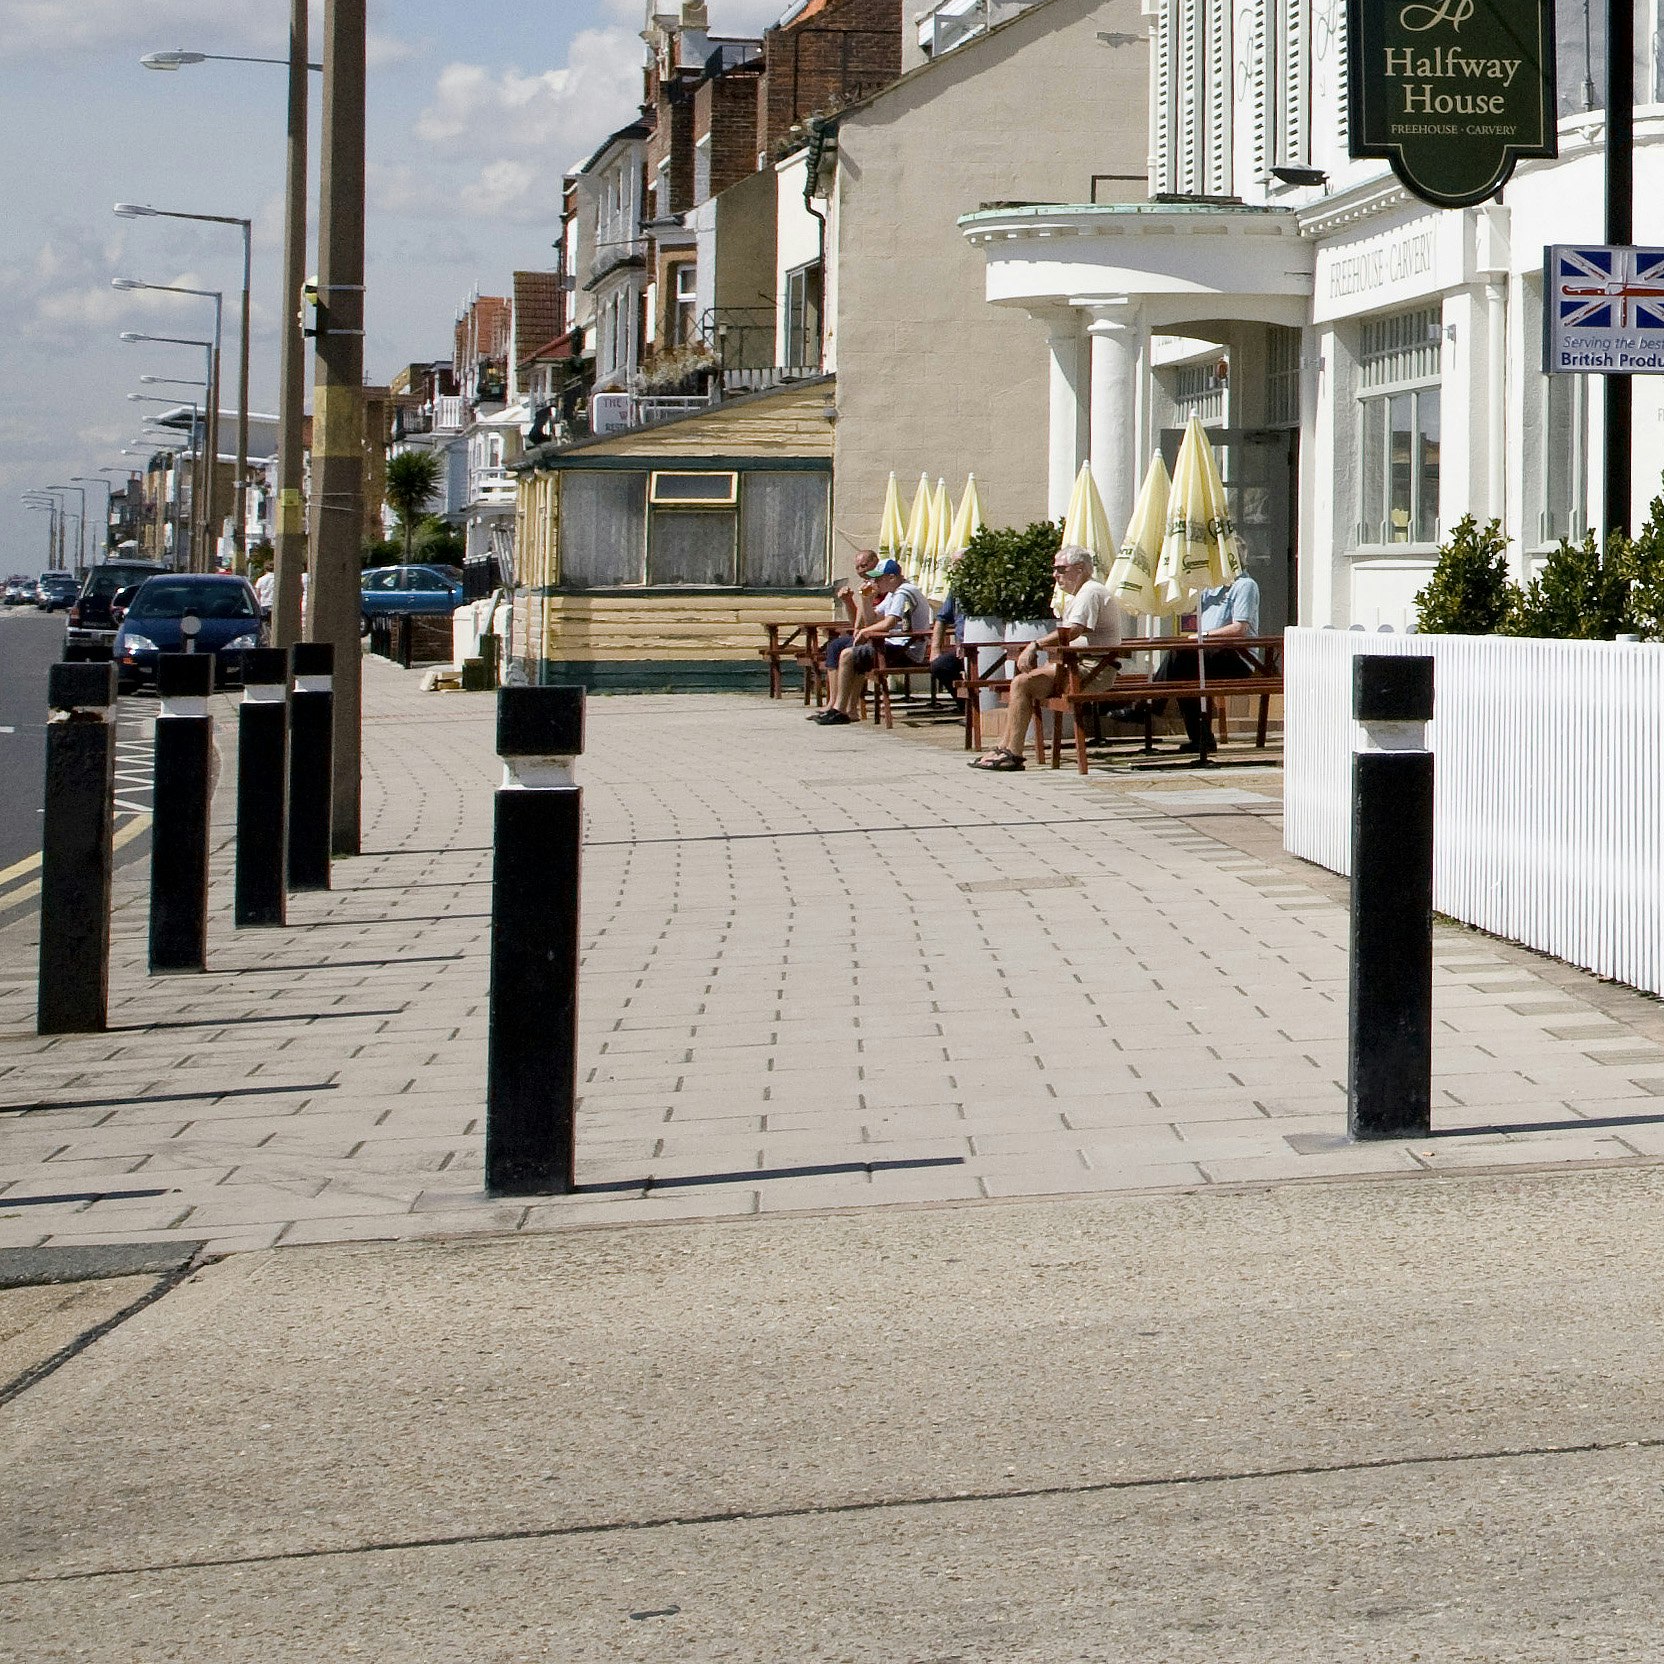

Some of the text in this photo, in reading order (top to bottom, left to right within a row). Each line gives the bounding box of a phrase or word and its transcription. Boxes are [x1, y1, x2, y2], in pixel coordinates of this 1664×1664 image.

[1383, 46, 1522, 88] Halfway
[1402, 84, 1505, 114] House
[1391, 124, 1517, 136] FREEHOUSE CARVERY
[1330, 231, 1433, 299] FREEHOUSE CARVERY
[1563, 336, 1611, 351] Serving
[1615, 337, 1635, 349] the
[1641, 338, 1664, 350] best
[1561, 352, 1613, 367] British
